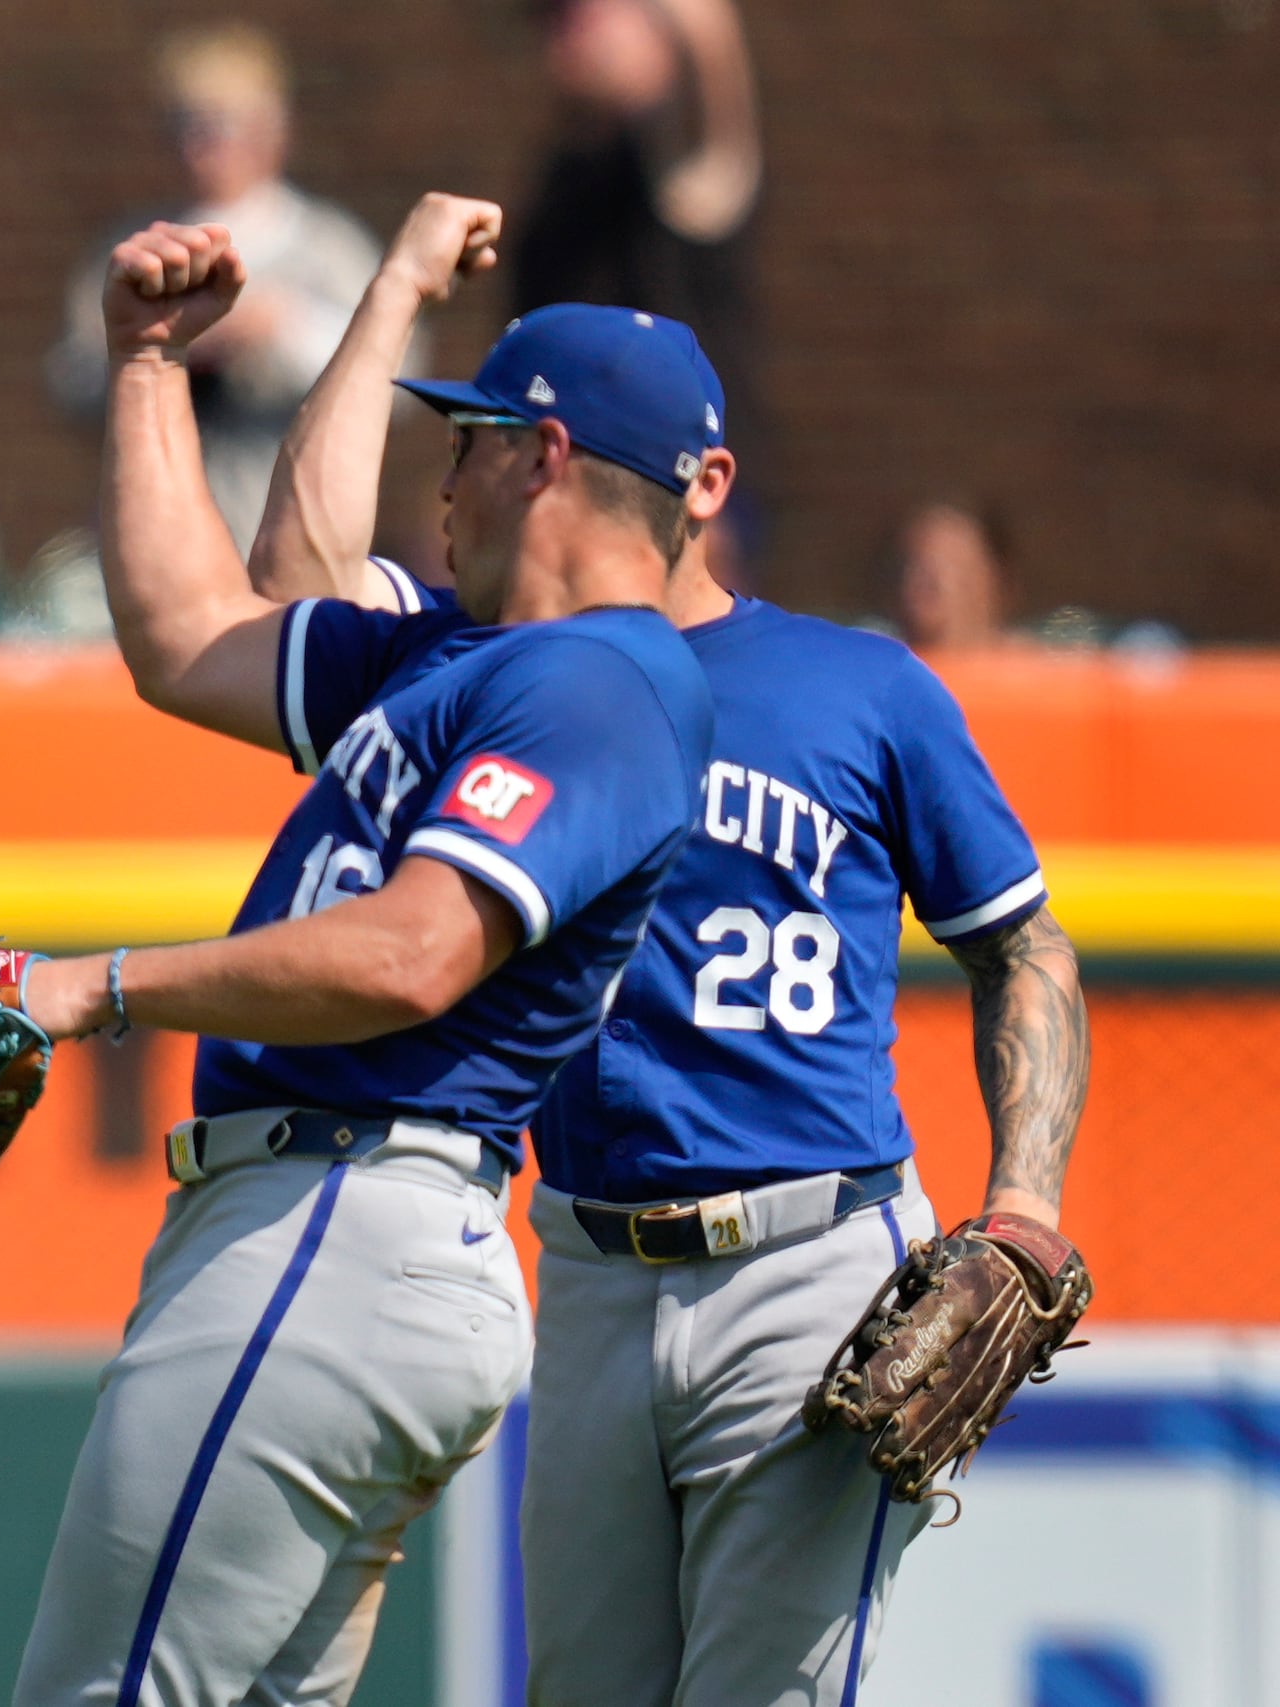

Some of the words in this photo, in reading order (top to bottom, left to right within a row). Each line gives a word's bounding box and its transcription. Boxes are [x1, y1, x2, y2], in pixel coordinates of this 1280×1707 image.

[457, 762, 535, 821] QT
[705, 760, 848, 899] CITY
[694, 906, 840, 1035] 28
[711, 1216, 741, 1249] 28
[887, 1303, 954, 1393] Rawlings
